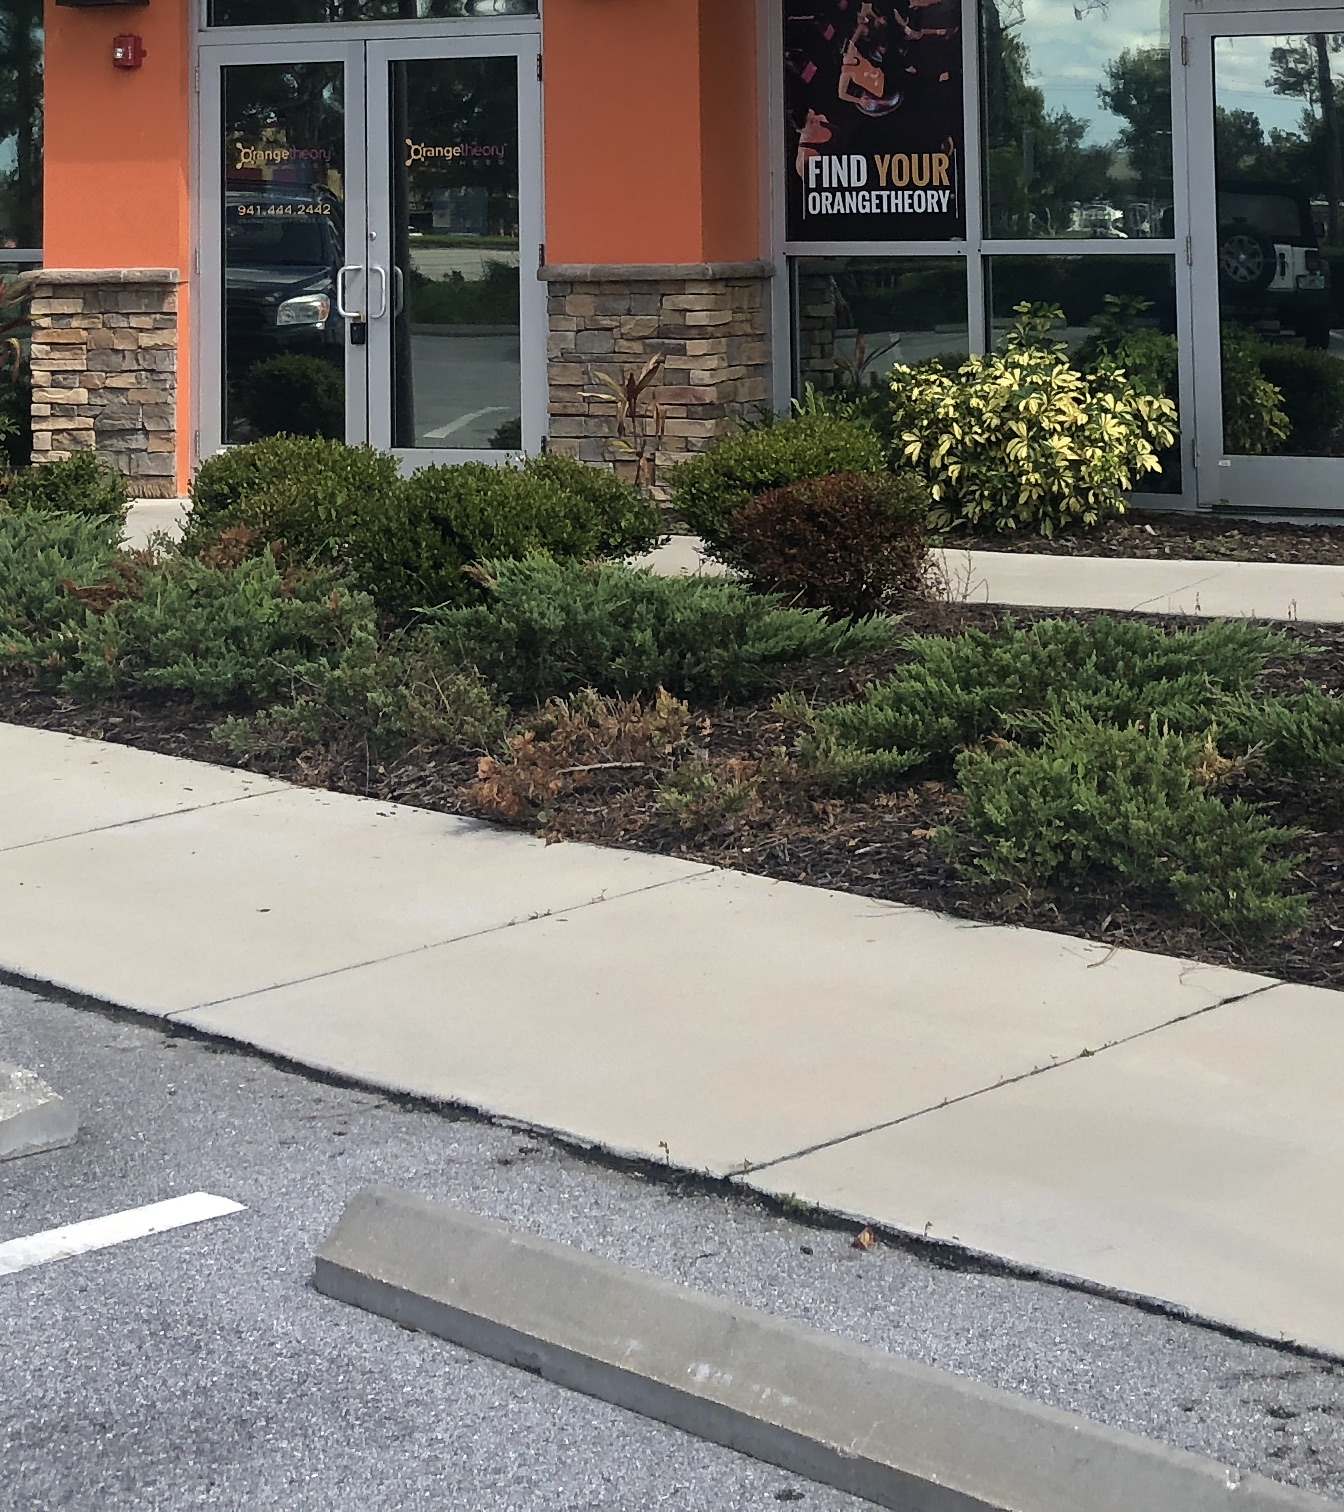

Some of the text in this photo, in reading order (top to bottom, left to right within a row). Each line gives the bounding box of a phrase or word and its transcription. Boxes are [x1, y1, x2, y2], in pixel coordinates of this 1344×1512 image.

[808, 153, 951, 188] FIND YOUR
[237, 204, 331, 216] 941.444.2442
[808, 190, 951, 215] ORANGETHEORY
